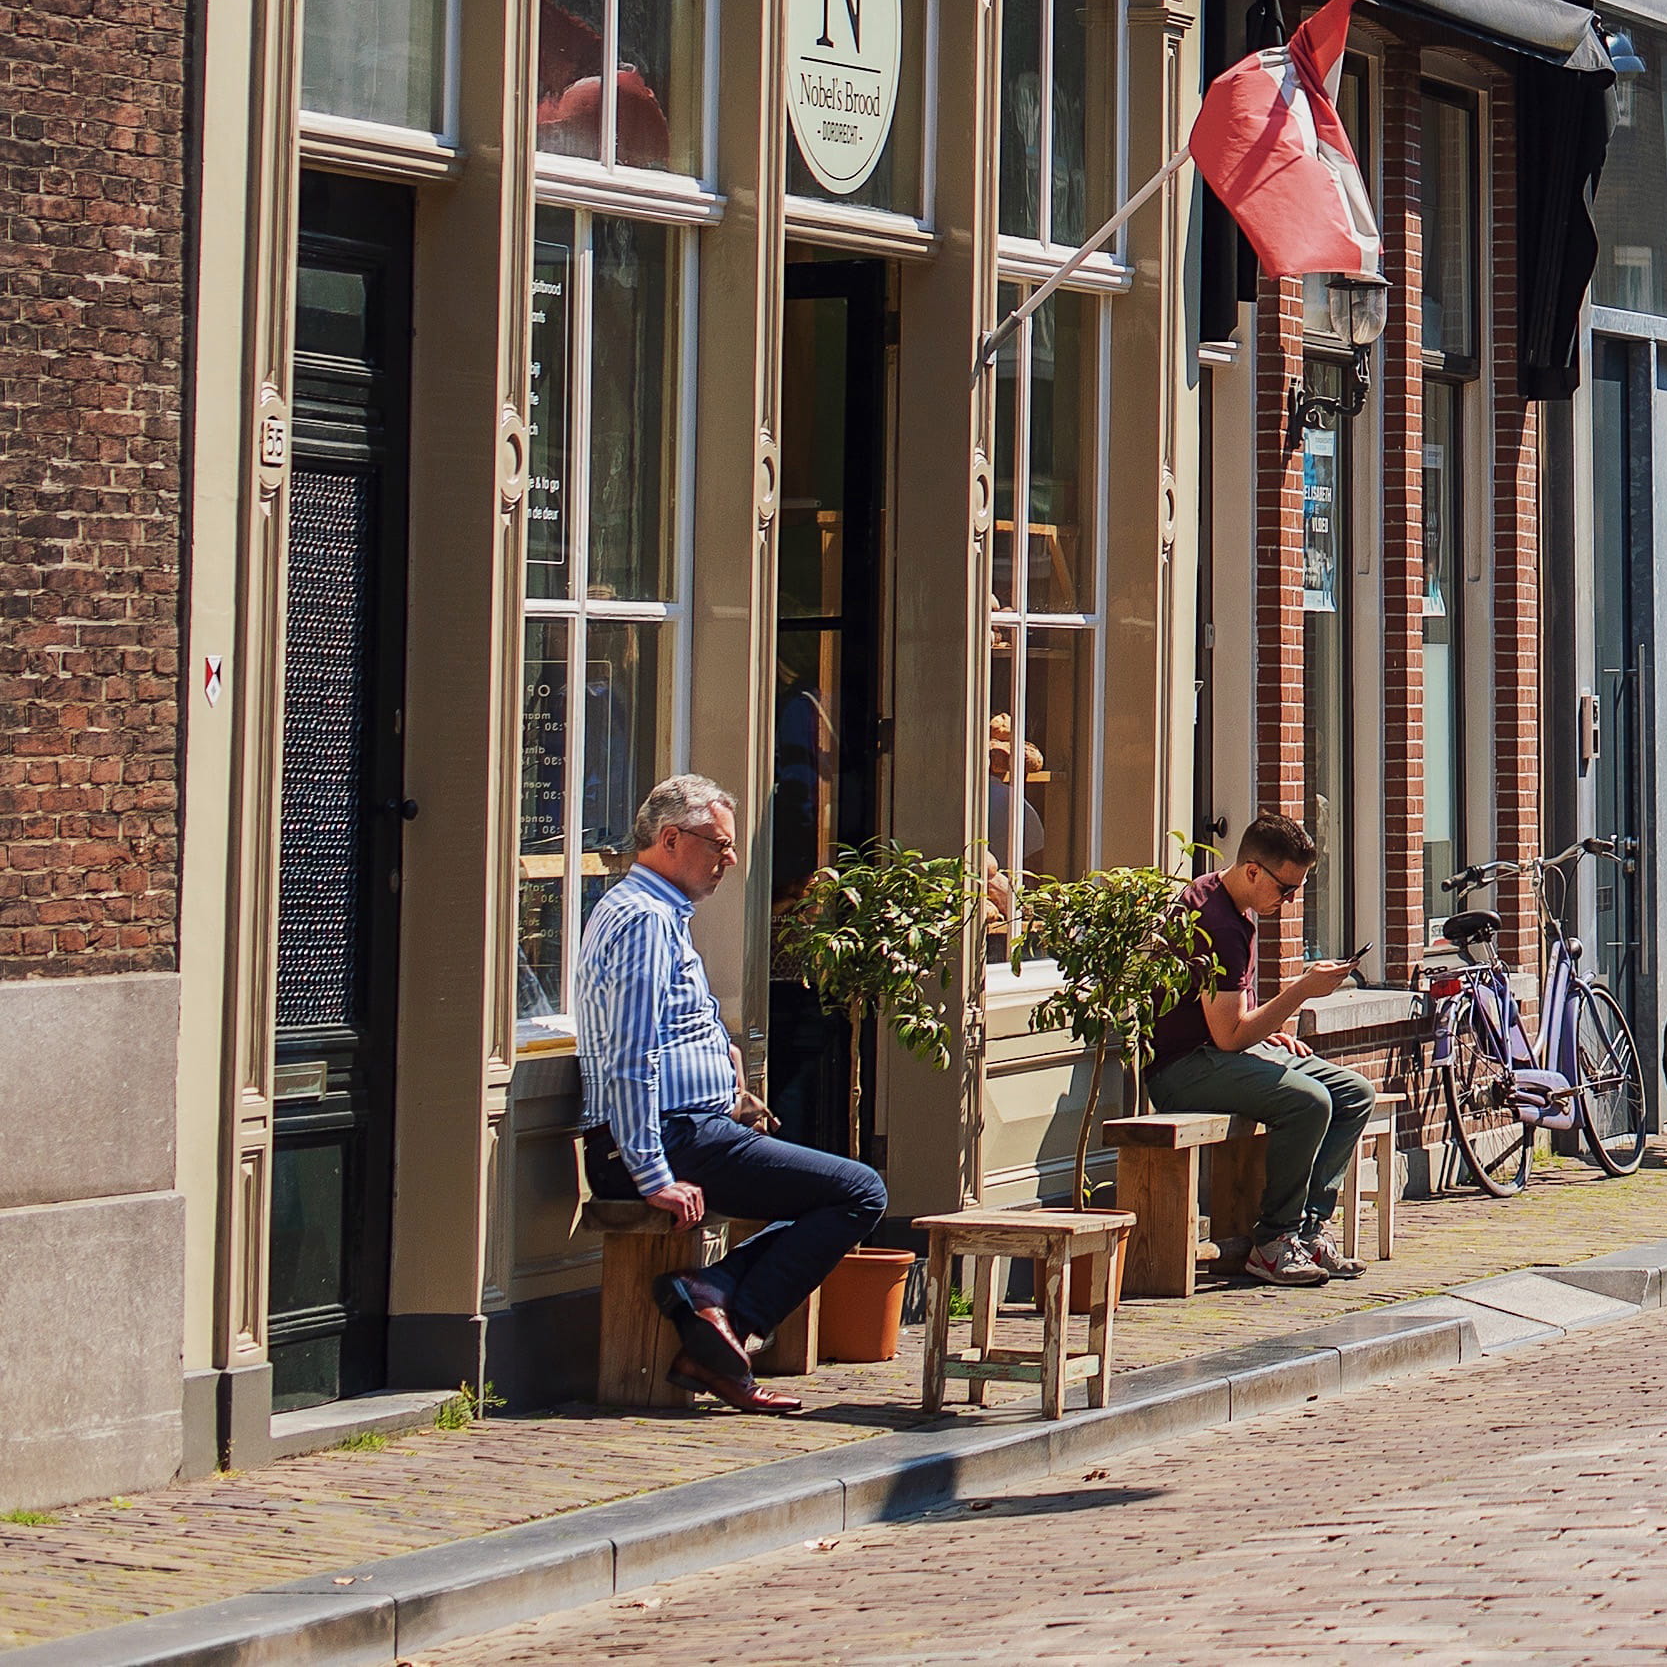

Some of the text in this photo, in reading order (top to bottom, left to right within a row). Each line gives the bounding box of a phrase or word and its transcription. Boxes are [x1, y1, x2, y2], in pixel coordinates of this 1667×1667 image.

[800, 72, 880, 117] Nobel's Brood
[267, 427, 284, 457] 55
[550, 479, 560, 494] go
[532, 506, 543, 520] de
